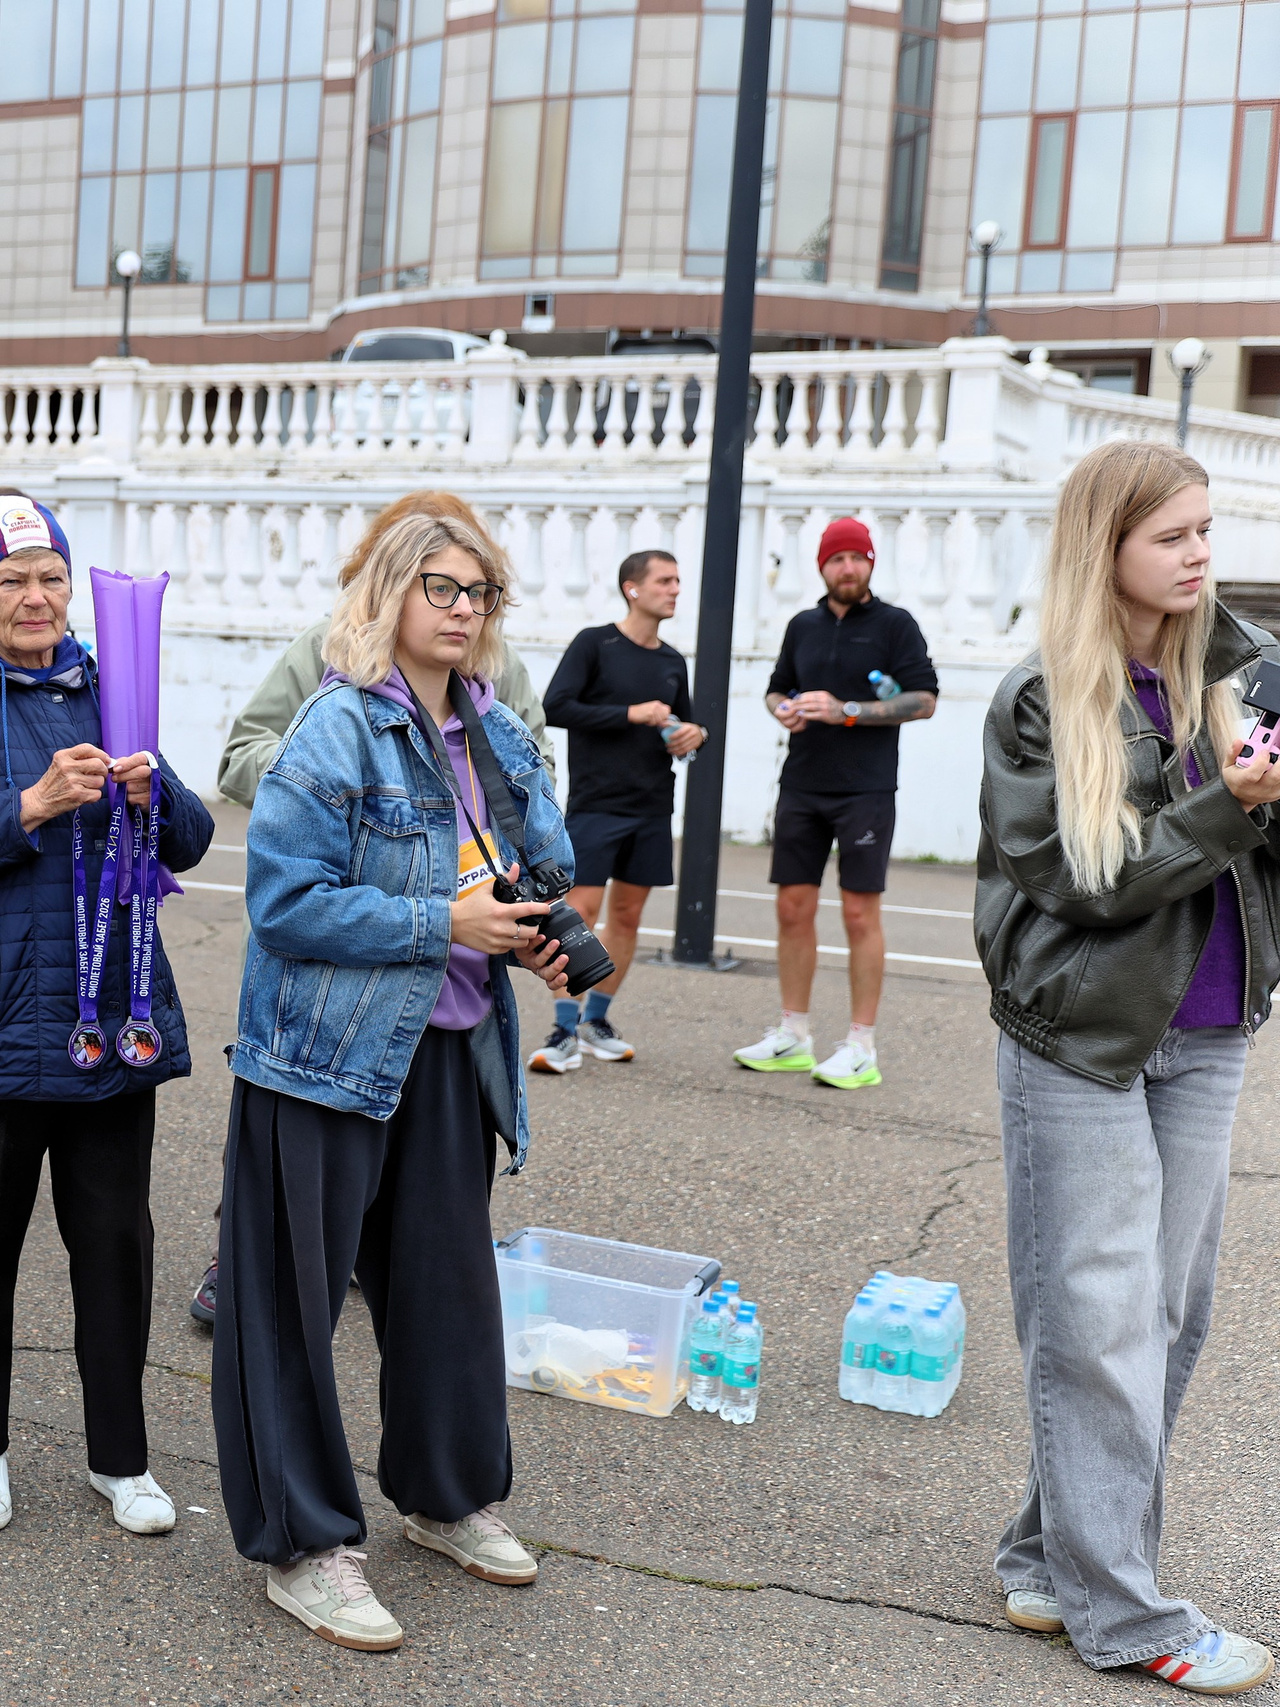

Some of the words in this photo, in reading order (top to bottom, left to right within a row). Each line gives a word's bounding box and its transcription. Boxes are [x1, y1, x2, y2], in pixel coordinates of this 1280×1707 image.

[105, 806, 122, 862] ЖИЗНЬ
[149, 805, 159, 860] ЖИЗНЬ
[76, 895, 88, 950] ФИОЛЕТОВЫЙ
[95, 920, 107, 943] ЗАБЕГ
[98, 897, 110, 919] 2026
[144, 919, 154, 943] ЗАБЕГ
[146, 896, 155, 918] 2026
[88, 945, 104, 998] ФИОЛЕТОВЫЙ
[139, 943, 152, 997] ФИОЛЕТОВЫЙ
